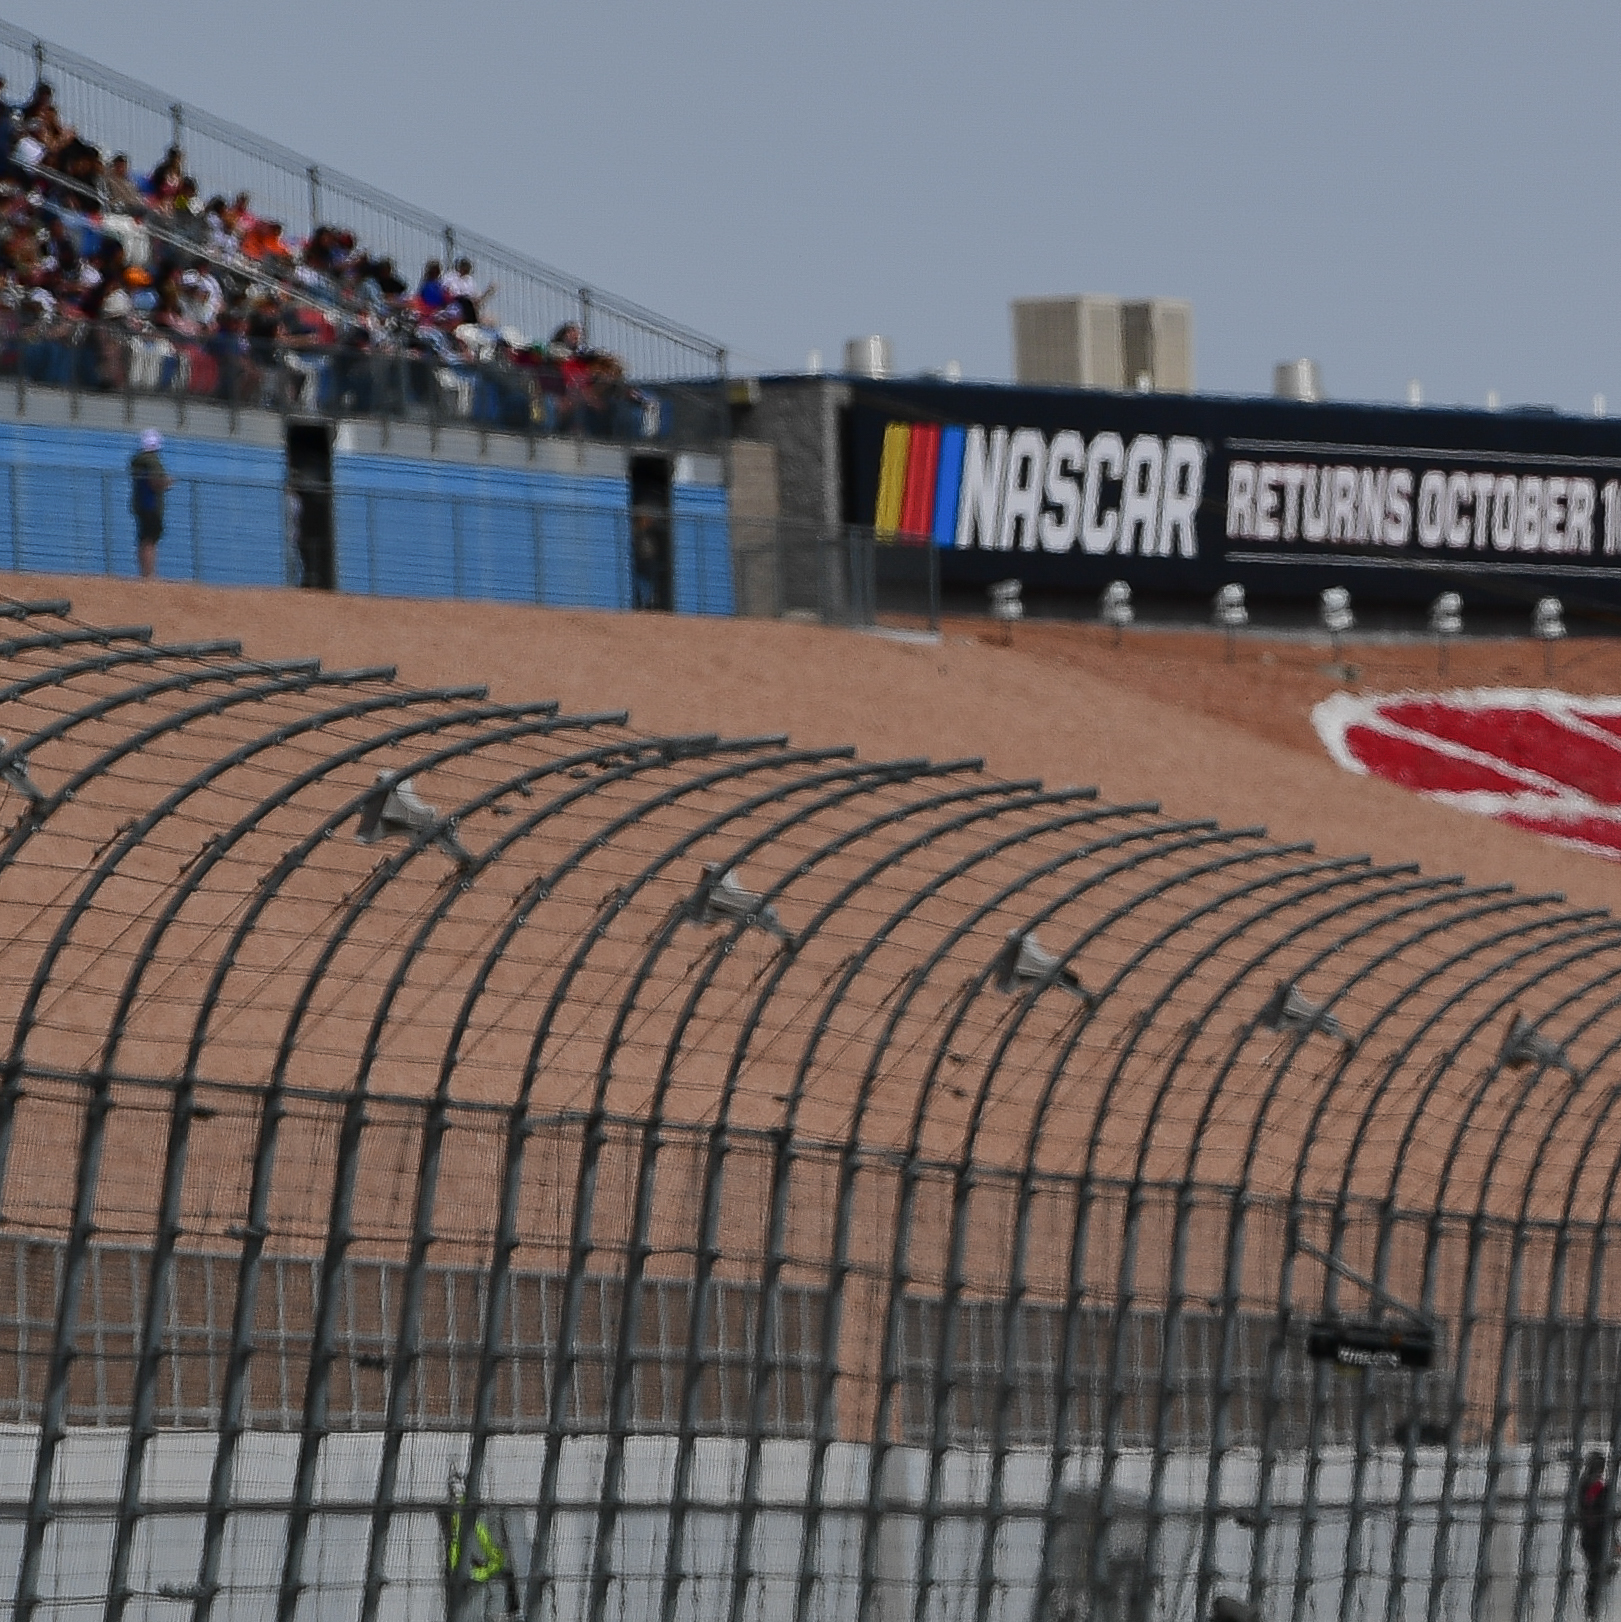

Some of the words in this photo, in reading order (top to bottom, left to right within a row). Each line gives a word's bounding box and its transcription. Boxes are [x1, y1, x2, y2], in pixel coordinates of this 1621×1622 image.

[956, 422, 1207, 560] NASCAR
[1225, 459, 1414, 549] RETURNS
[1417, 468, 1597, 557] OCTOBER
